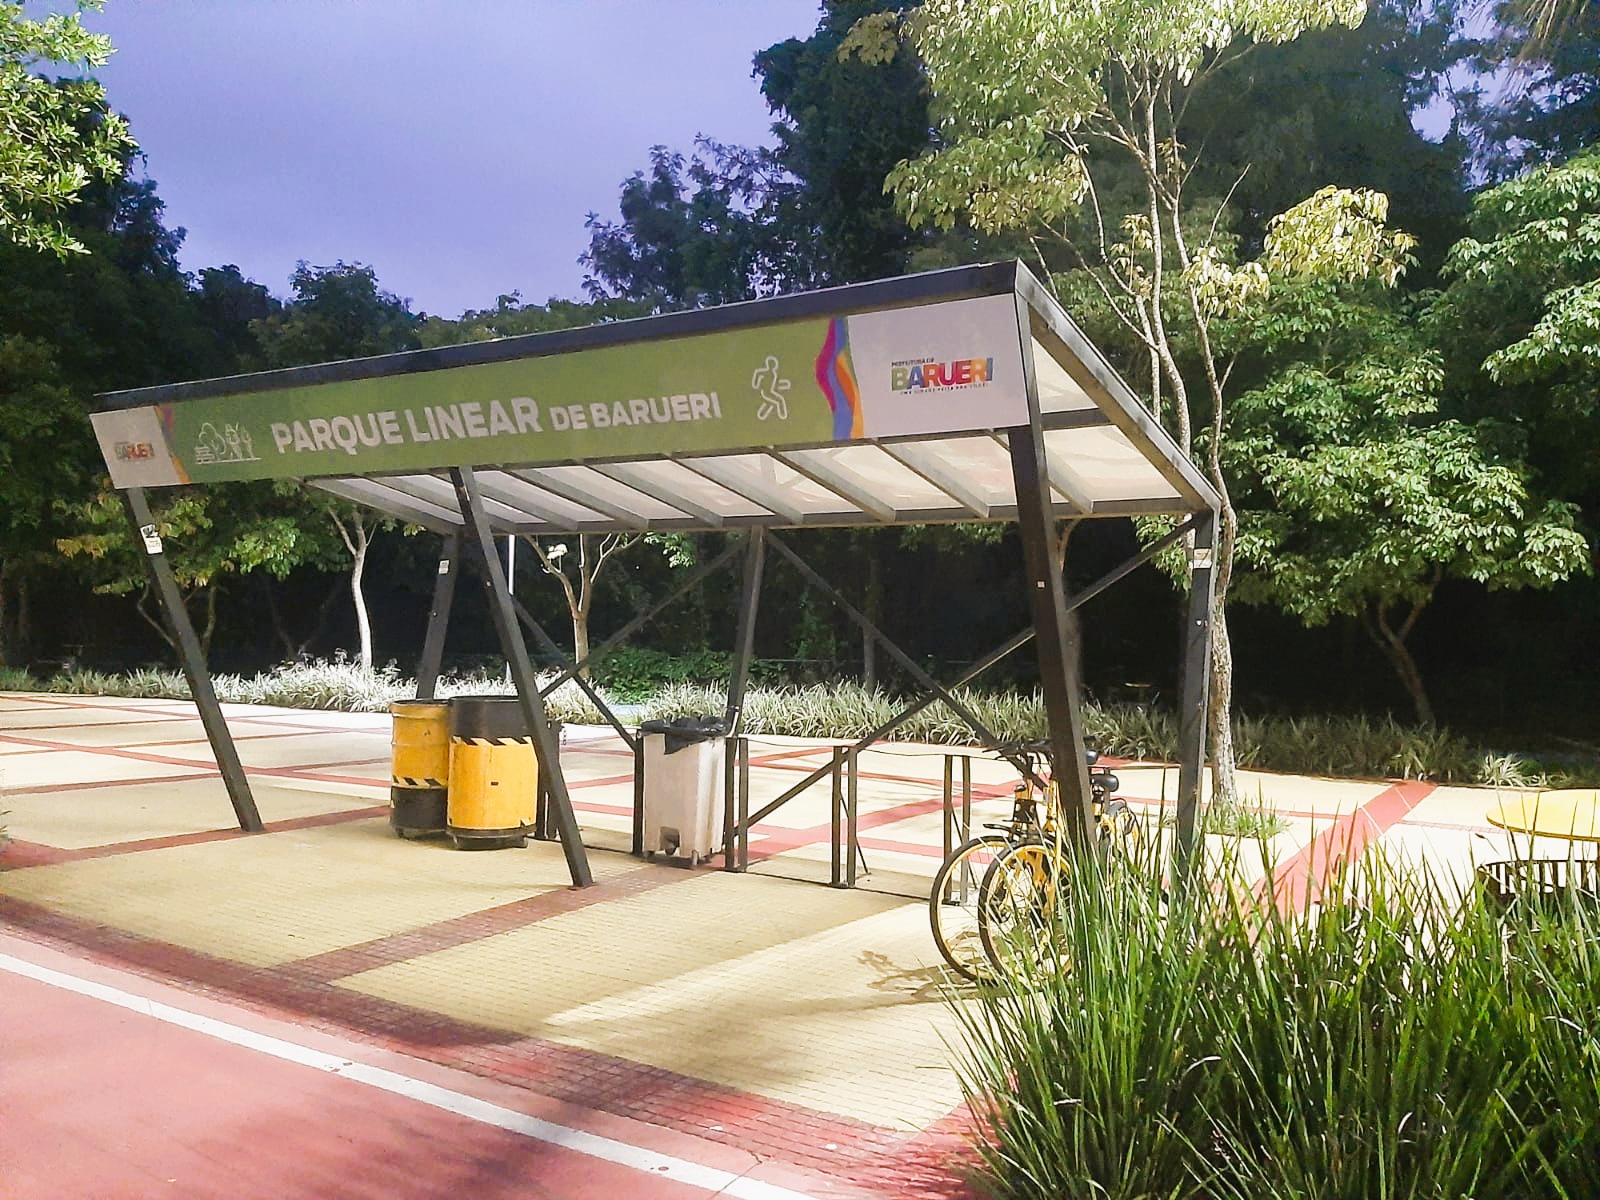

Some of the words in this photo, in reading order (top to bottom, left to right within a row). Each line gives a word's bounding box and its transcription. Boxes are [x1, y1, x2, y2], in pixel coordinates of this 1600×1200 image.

[892, 358, 993, 391] BARUERI
[271, 411, 401, 454] PARQUE
[404, 397, 543, 442] LINEAR
[550, 404, 588, 431] DE
[590, 392, 722, 428] BARUERI
